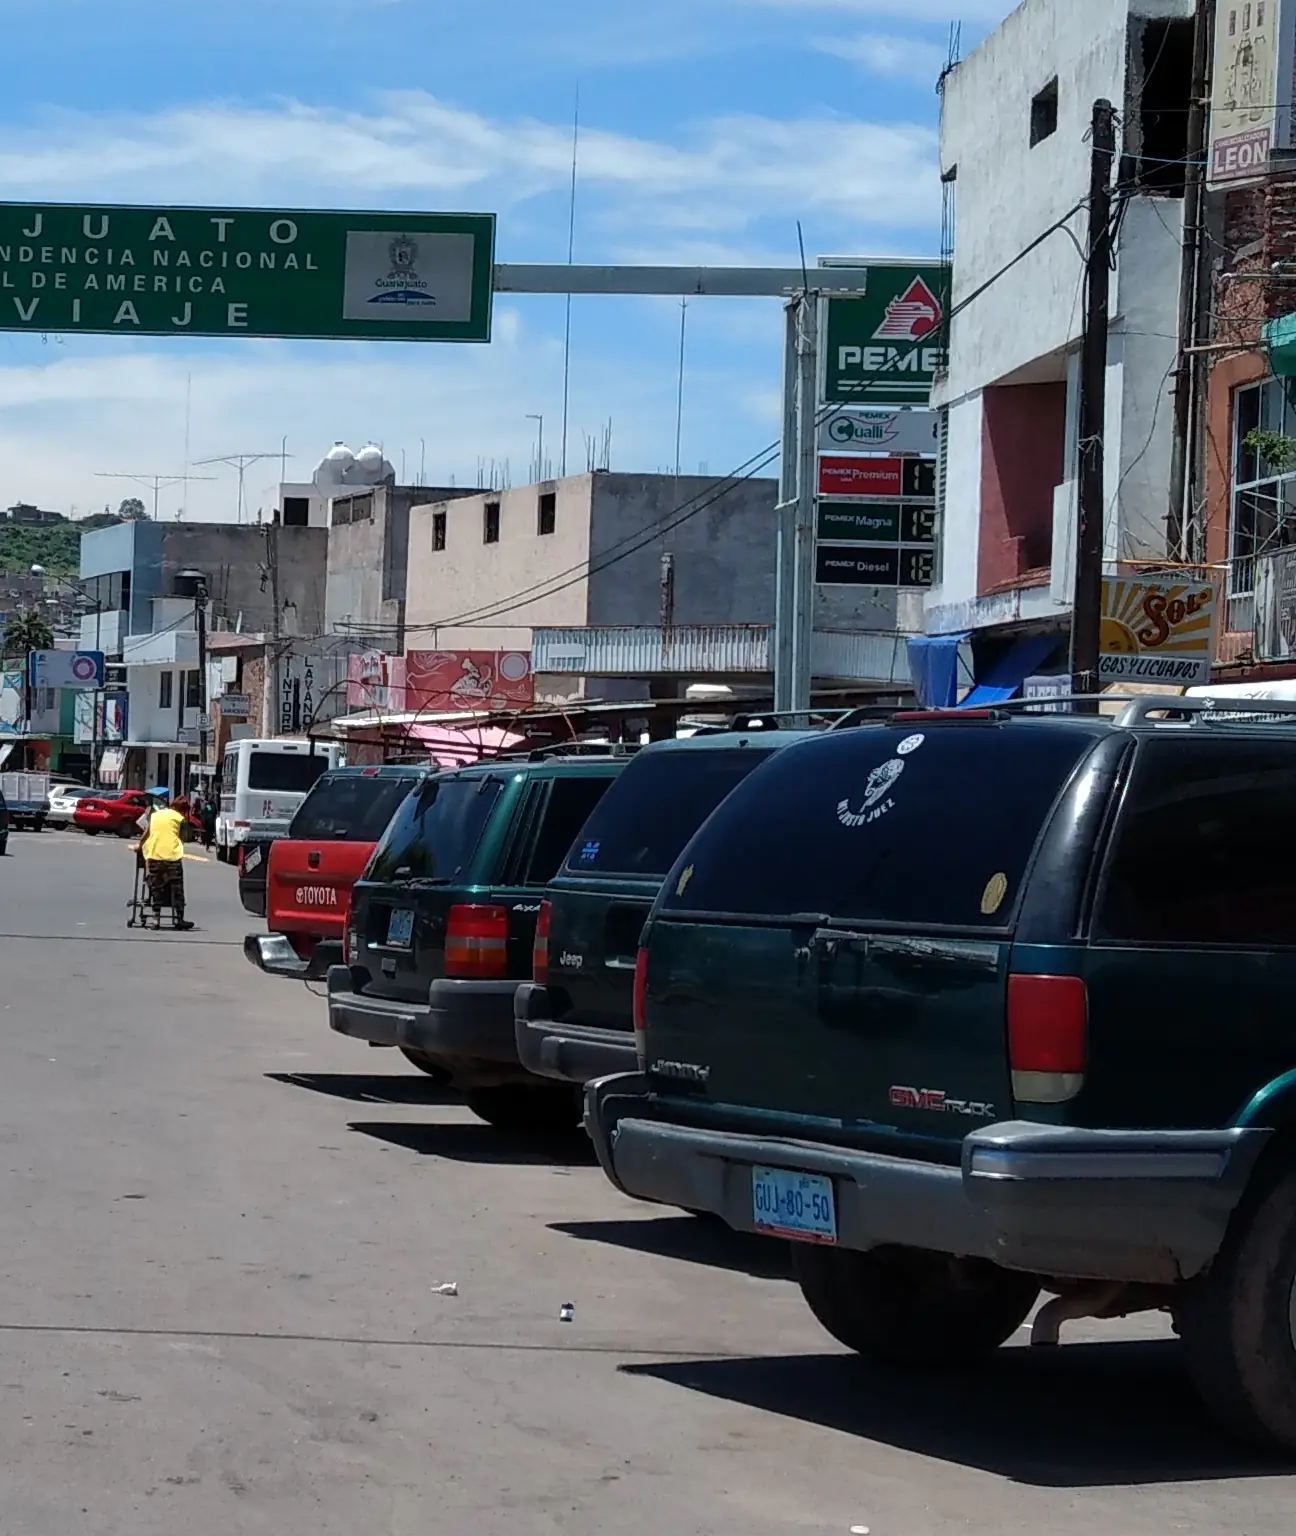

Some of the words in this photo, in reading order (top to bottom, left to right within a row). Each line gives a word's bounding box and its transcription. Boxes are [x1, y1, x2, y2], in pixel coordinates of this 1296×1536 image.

[1214, 140, 1268, 174] LEON
[153, 249, 319, 270] NACIONAL
[31, 272, 67, 290] DE
[84, 273, 226, 294] AMERICA
[375, 278, 428, 290] Guanajuato
[13, 297, 249, 327] VIAJE
[838, 346, 949, 372] PEME
[852, 468, 899, 480] Premium
[855, 515, 893, 529] Magna
[857, 561, 890, 572] Diesel
[1136, 658, 1201, 679] LICUADOS
[866, 797, 896, 823] JUEZ
[304, 886, 337, 905] TOYOTA
[559, 951, 583, 968] Jeep
[889, 1085, 945, 1111] GMC
[944, 1099, 996, 1117] TRUCK
[755, 1183, 830, 1222] GUJ-80-50
